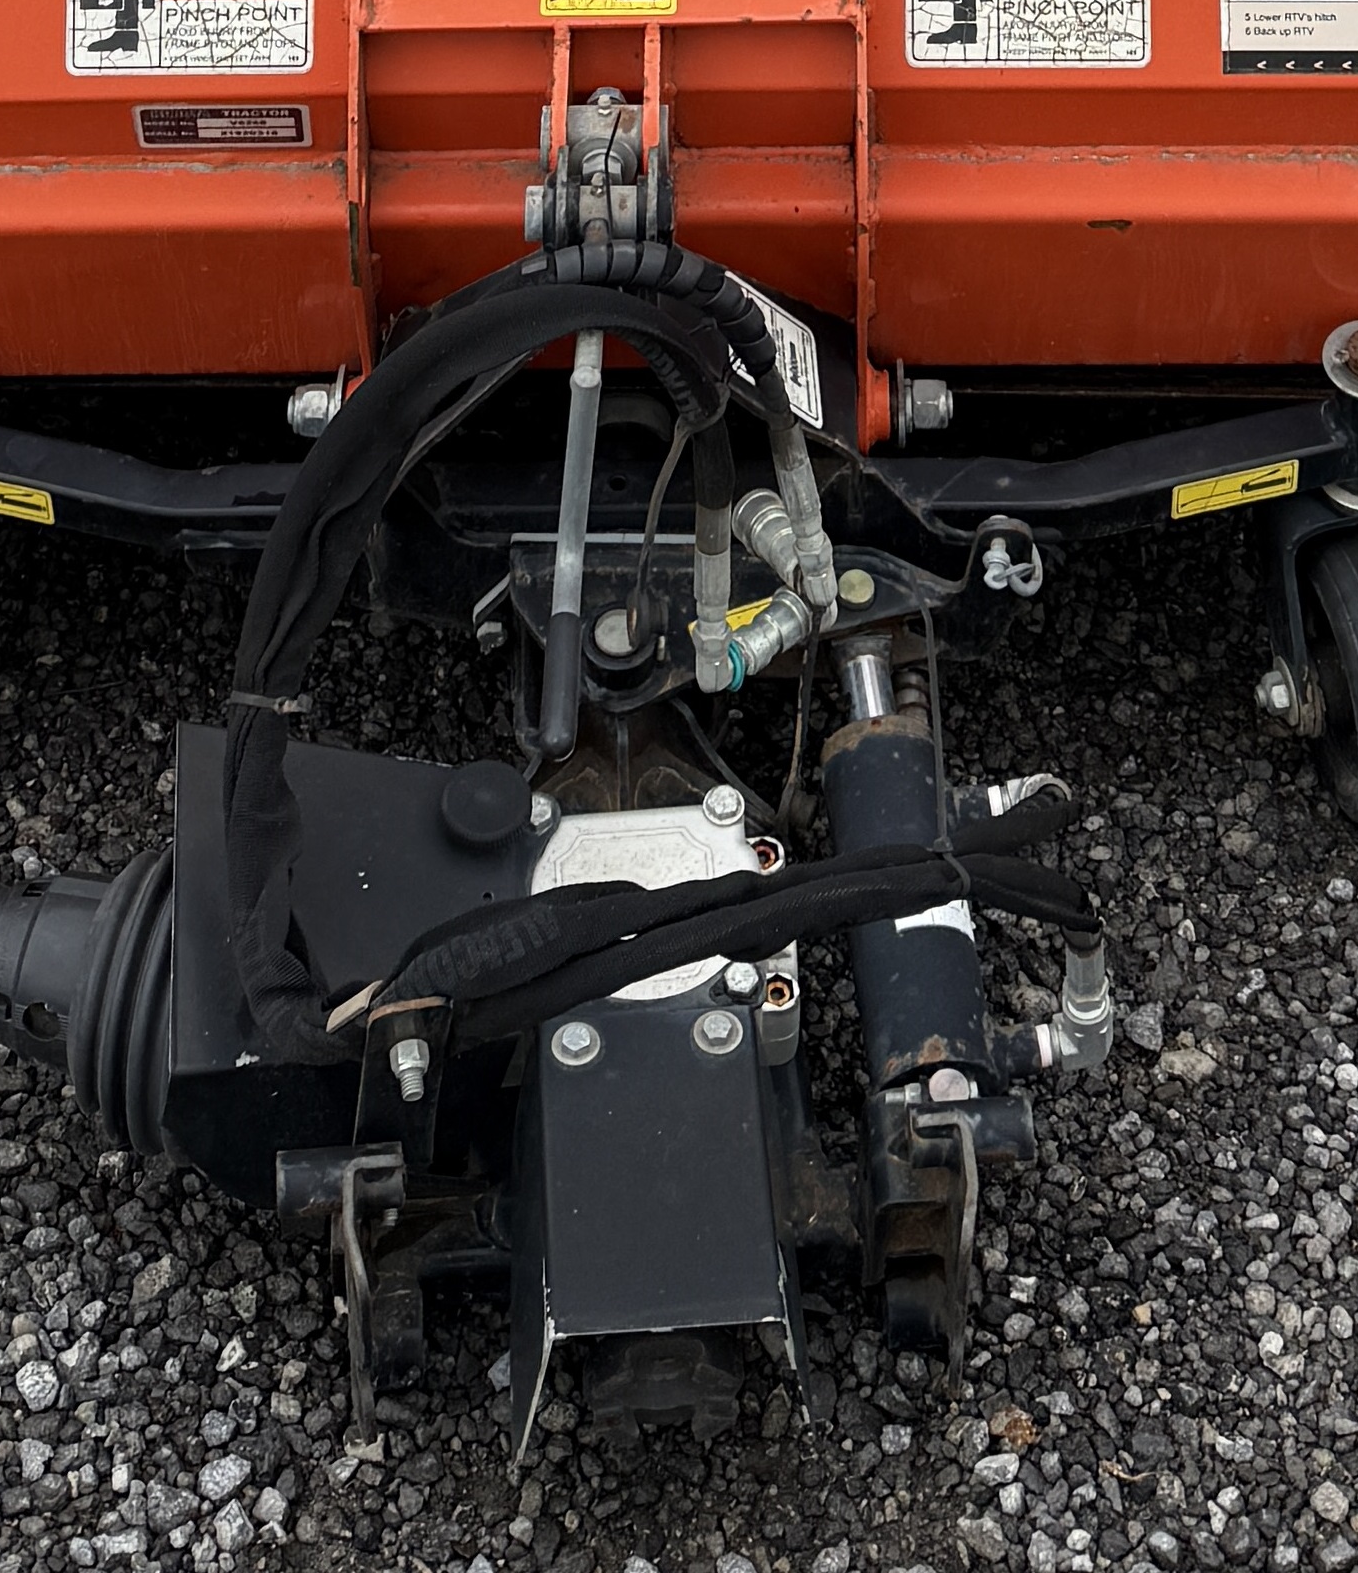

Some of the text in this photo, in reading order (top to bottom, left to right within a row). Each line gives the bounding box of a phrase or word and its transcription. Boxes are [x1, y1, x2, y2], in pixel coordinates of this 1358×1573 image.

[1003, 0, 1142, 15] PINCH POINT
[238, 7, 303, 21] POINT
[1253, 13, 1281, 21] Lower
[1315, 13, 1336, 21] hitch
[1253, 27, 1276, 35] Back
[1280, 28, 1291, 37] up
[1294, 27, 1315, 35] RTV
